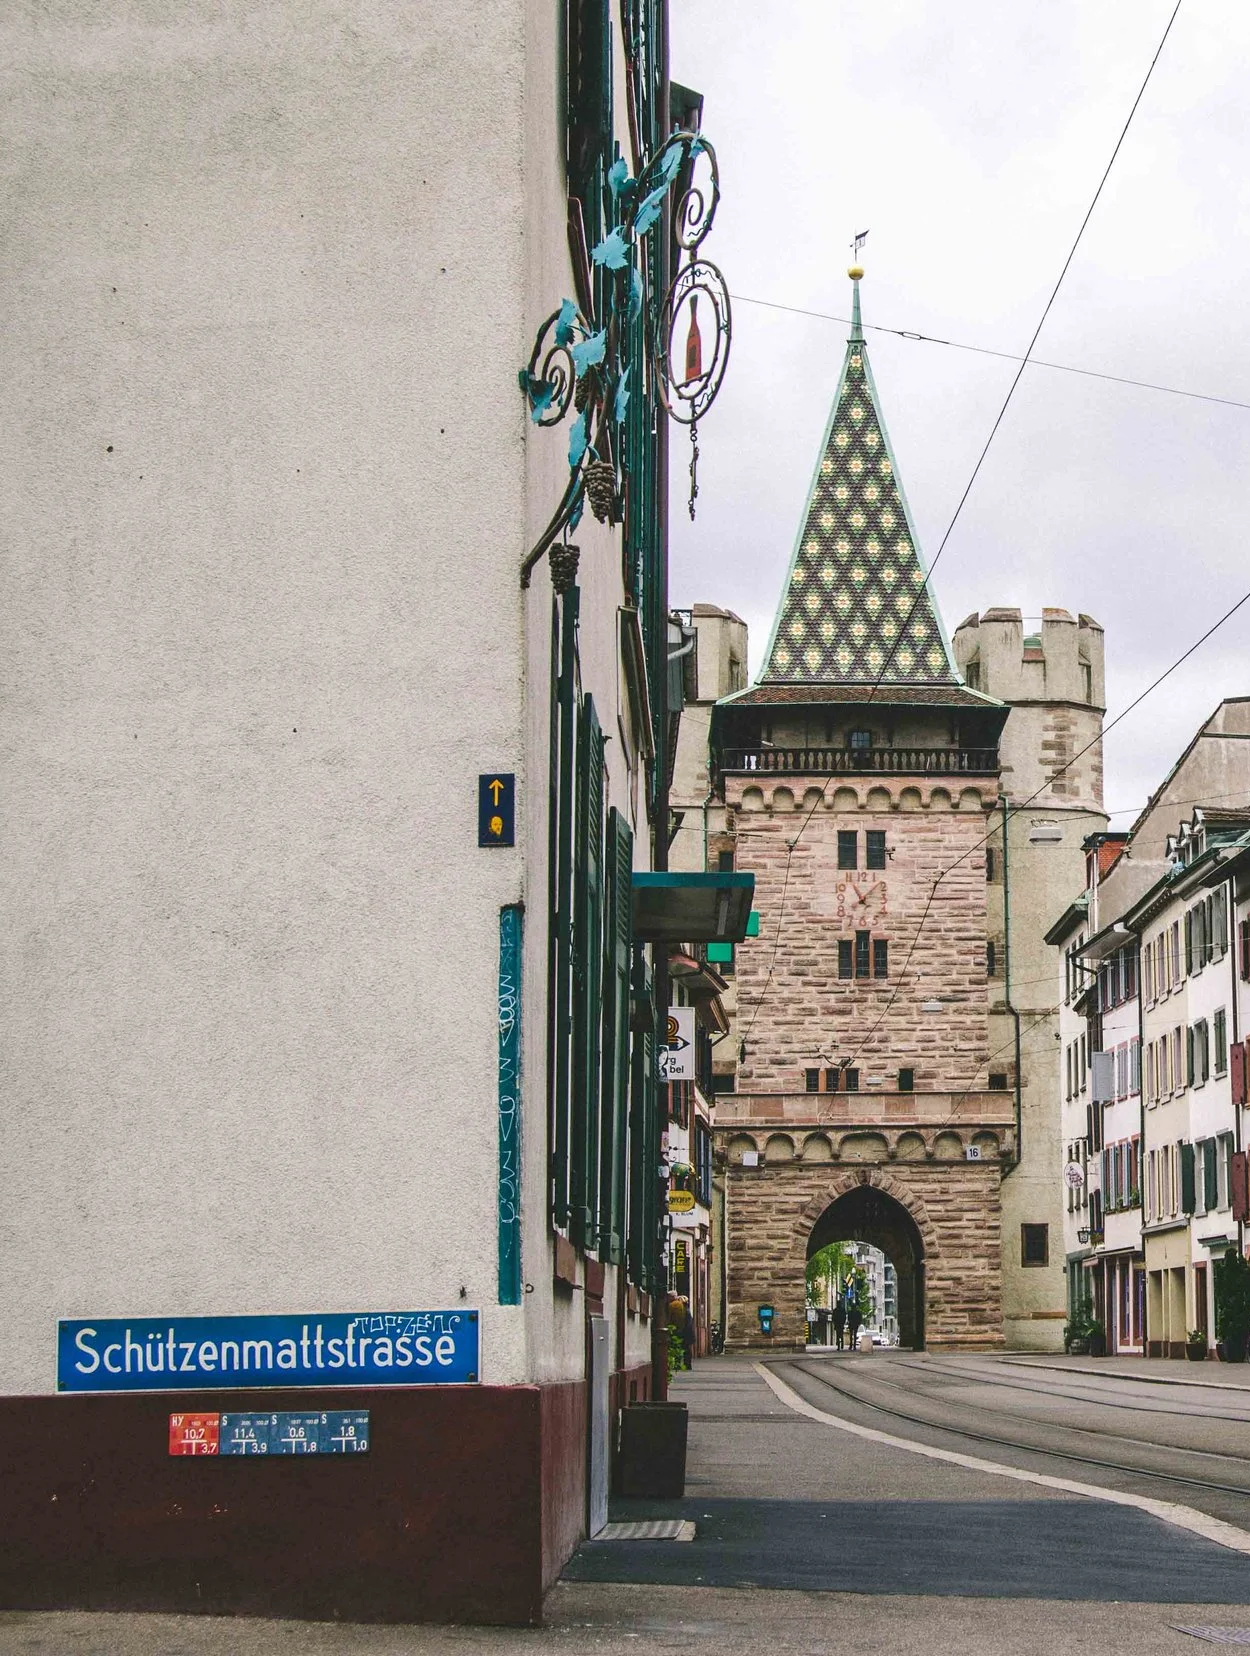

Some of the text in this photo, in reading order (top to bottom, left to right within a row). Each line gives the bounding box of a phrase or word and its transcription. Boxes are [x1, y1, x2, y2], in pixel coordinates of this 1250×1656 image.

[846, 872, 852, 882] 11
[858, 872, 867, 882] 12
[836, 883, 846, 893] 10
[880, 881, 887, 891] 2
[837, 894, 845, 904] 9
[881, 893, 887, 904] 3
[837, 905, 845, 917] 8
[880, 905, 888, 914] 4
[847, 915, 853, 927] 7
[859, 916, 867, 926] 6
[872, 915, 878, 925] 5
[970, 1148, 978, 1157] 16
[75, 1324, 456, 1374] Schützenmattstrasse
[172, 1415, 184, 1426] HY
[222, 1415, 228, 1426] S
[271, 1414, 277, 1425] S
[321, 1414, 327, 1424] S
